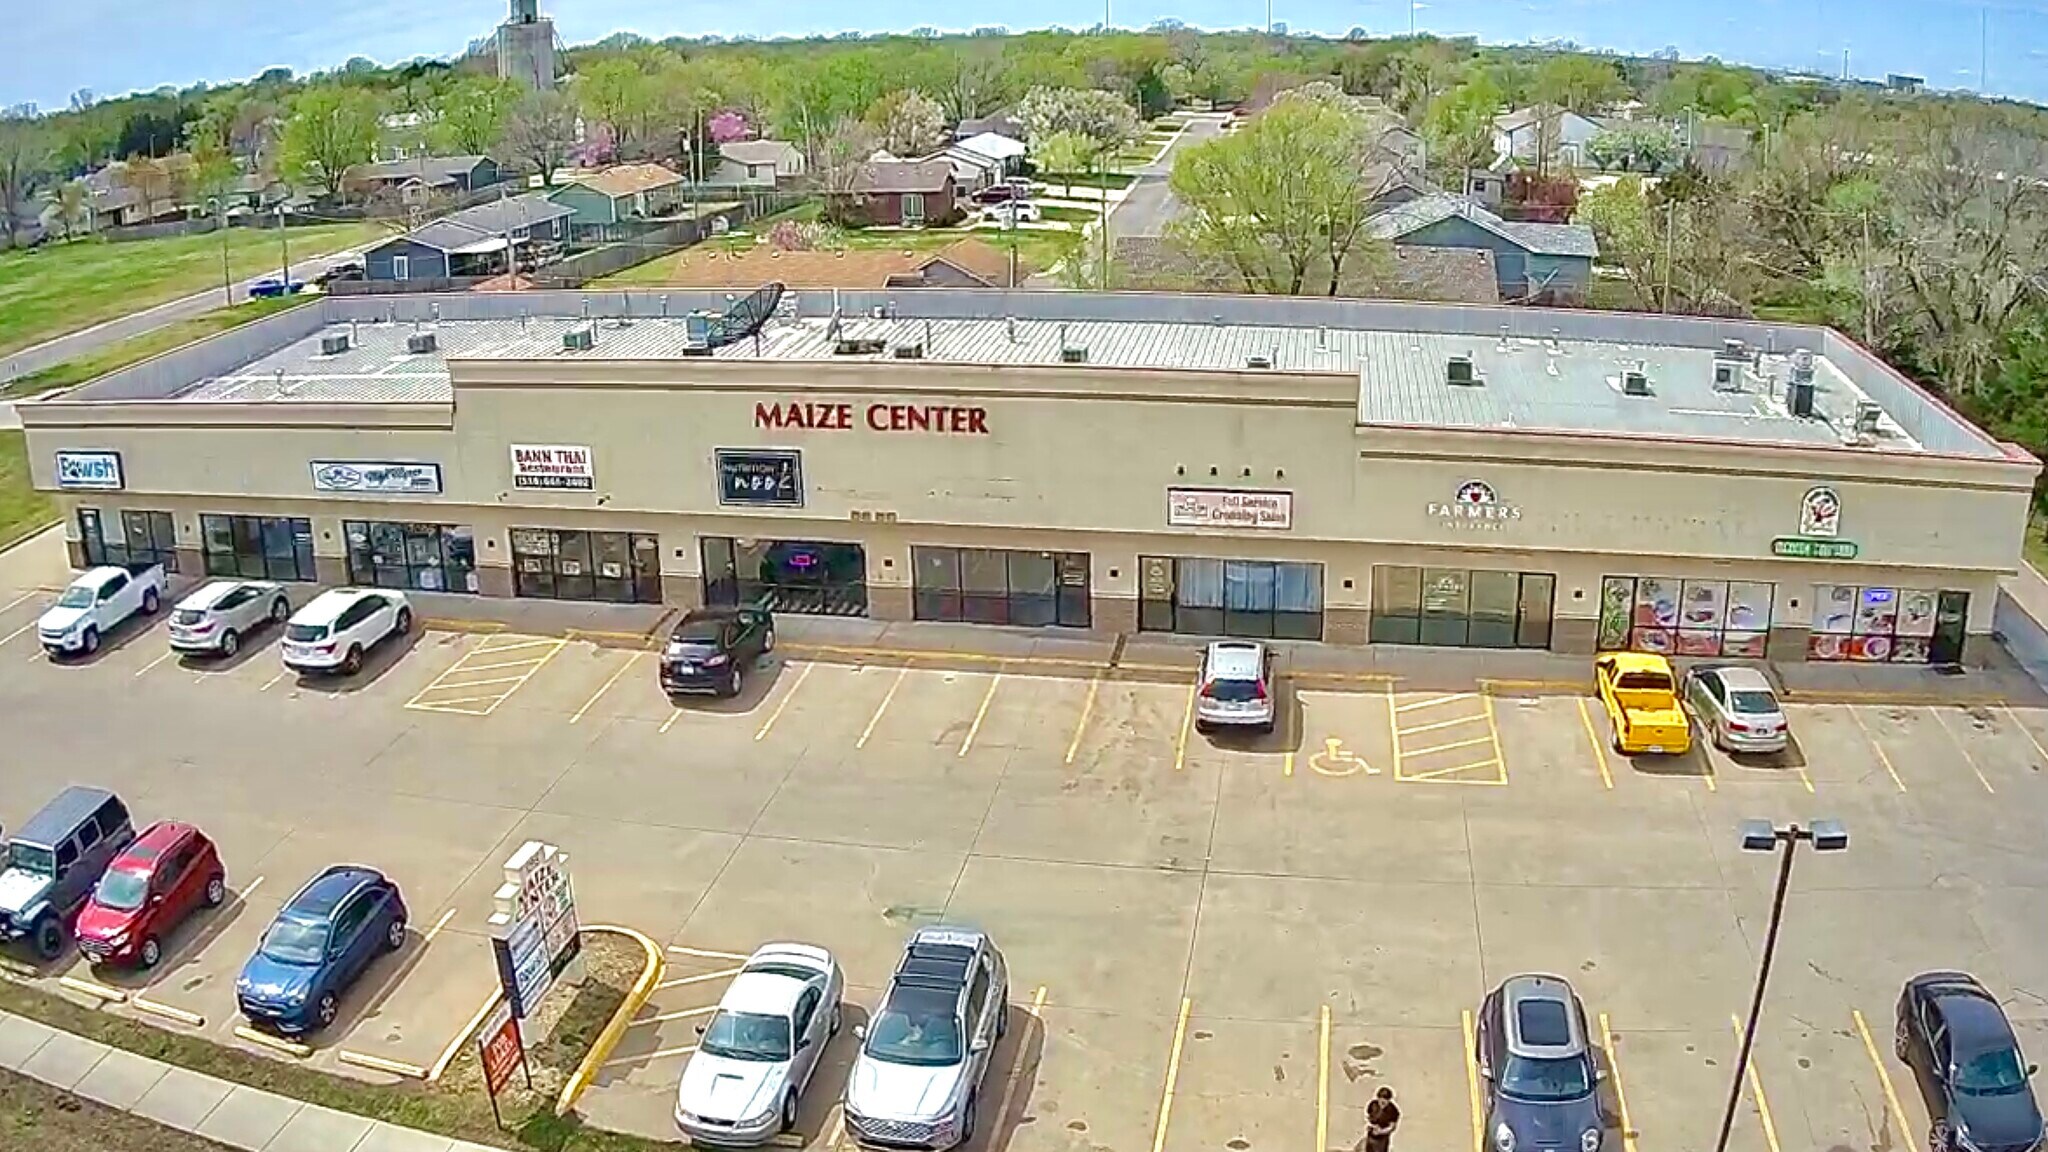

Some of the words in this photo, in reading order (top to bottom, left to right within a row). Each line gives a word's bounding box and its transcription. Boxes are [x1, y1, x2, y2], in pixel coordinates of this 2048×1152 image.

[755, 402, 853, 430] MAIZE
[866, 404, 989, 434] CENTER
[515, 449, 552, 463] BANN
[554, 450, 587, 464] THAI
[1427, 503, 1521, 519] FARMERS
